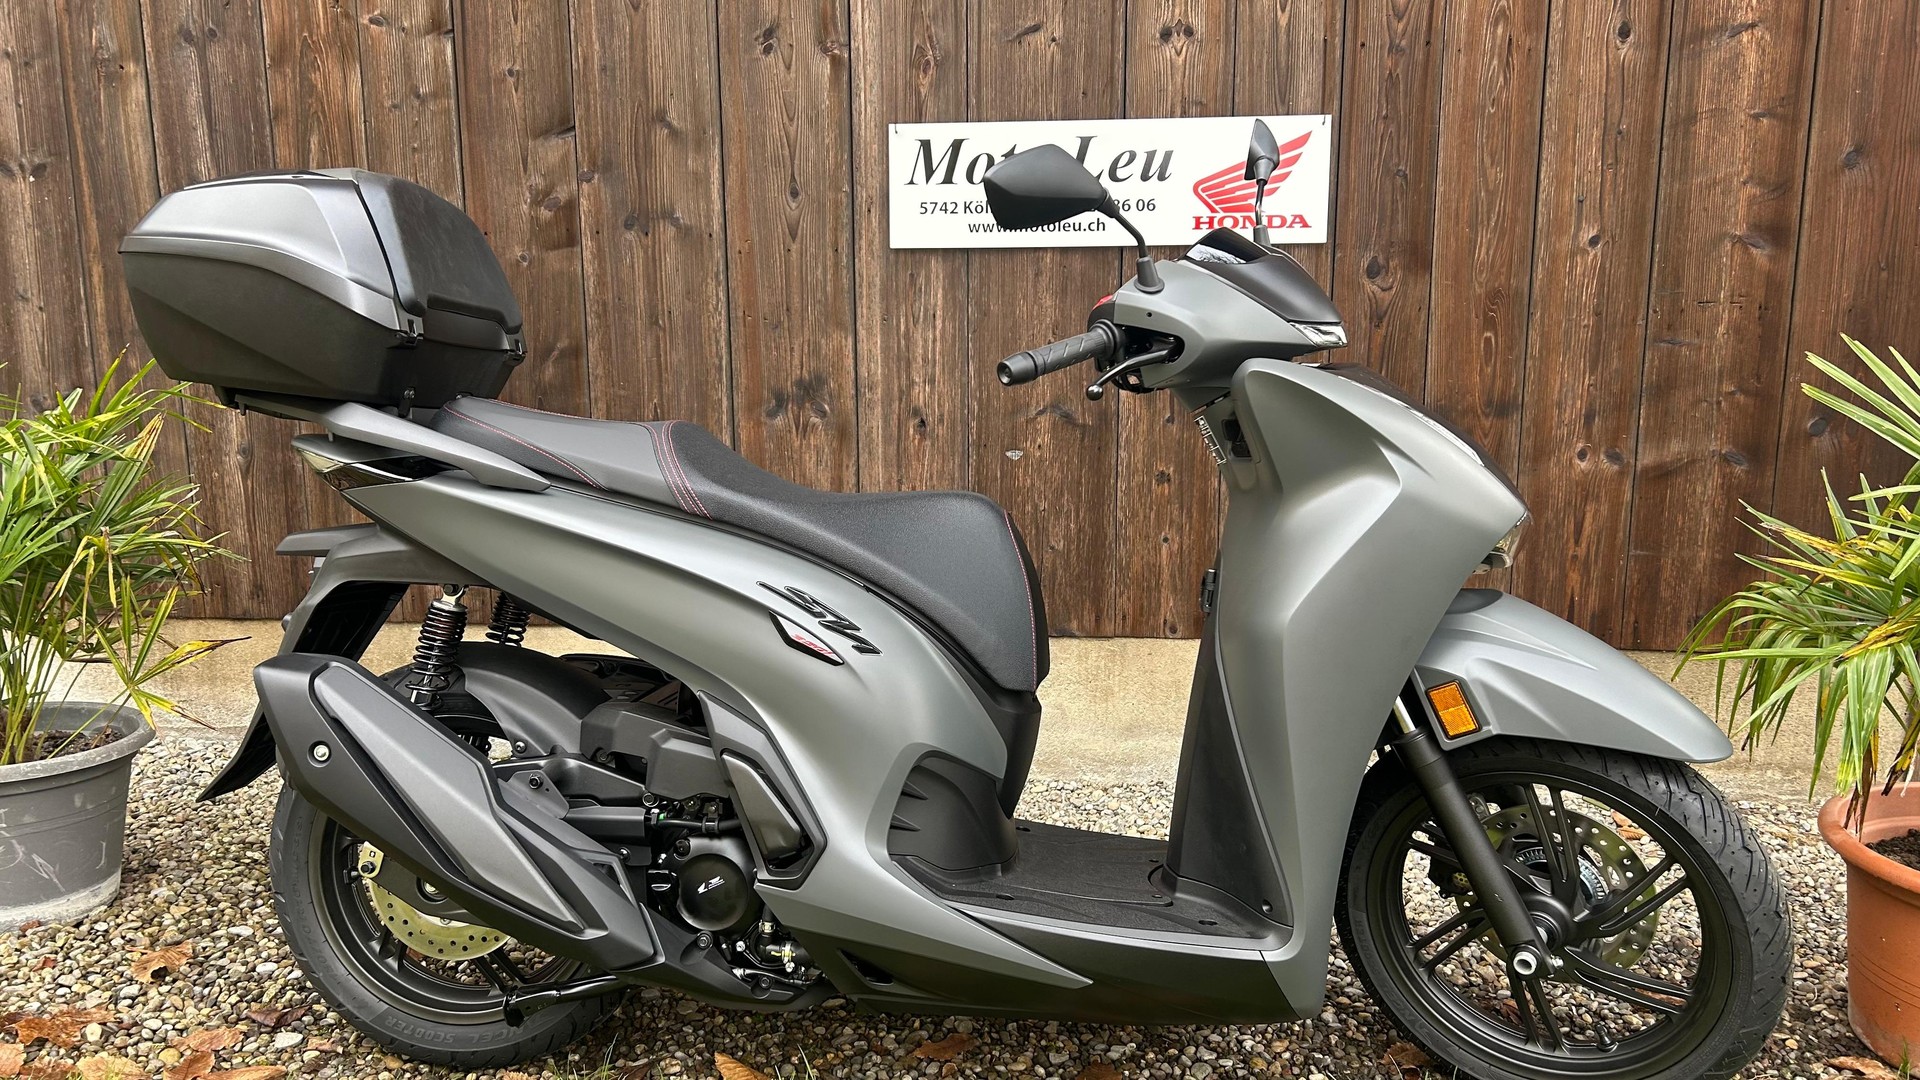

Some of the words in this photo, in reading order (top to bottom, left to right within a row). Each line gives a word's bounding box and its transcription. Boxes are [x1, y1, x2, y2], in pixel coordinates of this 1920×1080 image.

[919, 201, 959, 215] 5742
[963, 200, 988, 215] Köl
[1136, 198, 1156, 212] 06
[1192, 214, 1312, 230] HONDA
